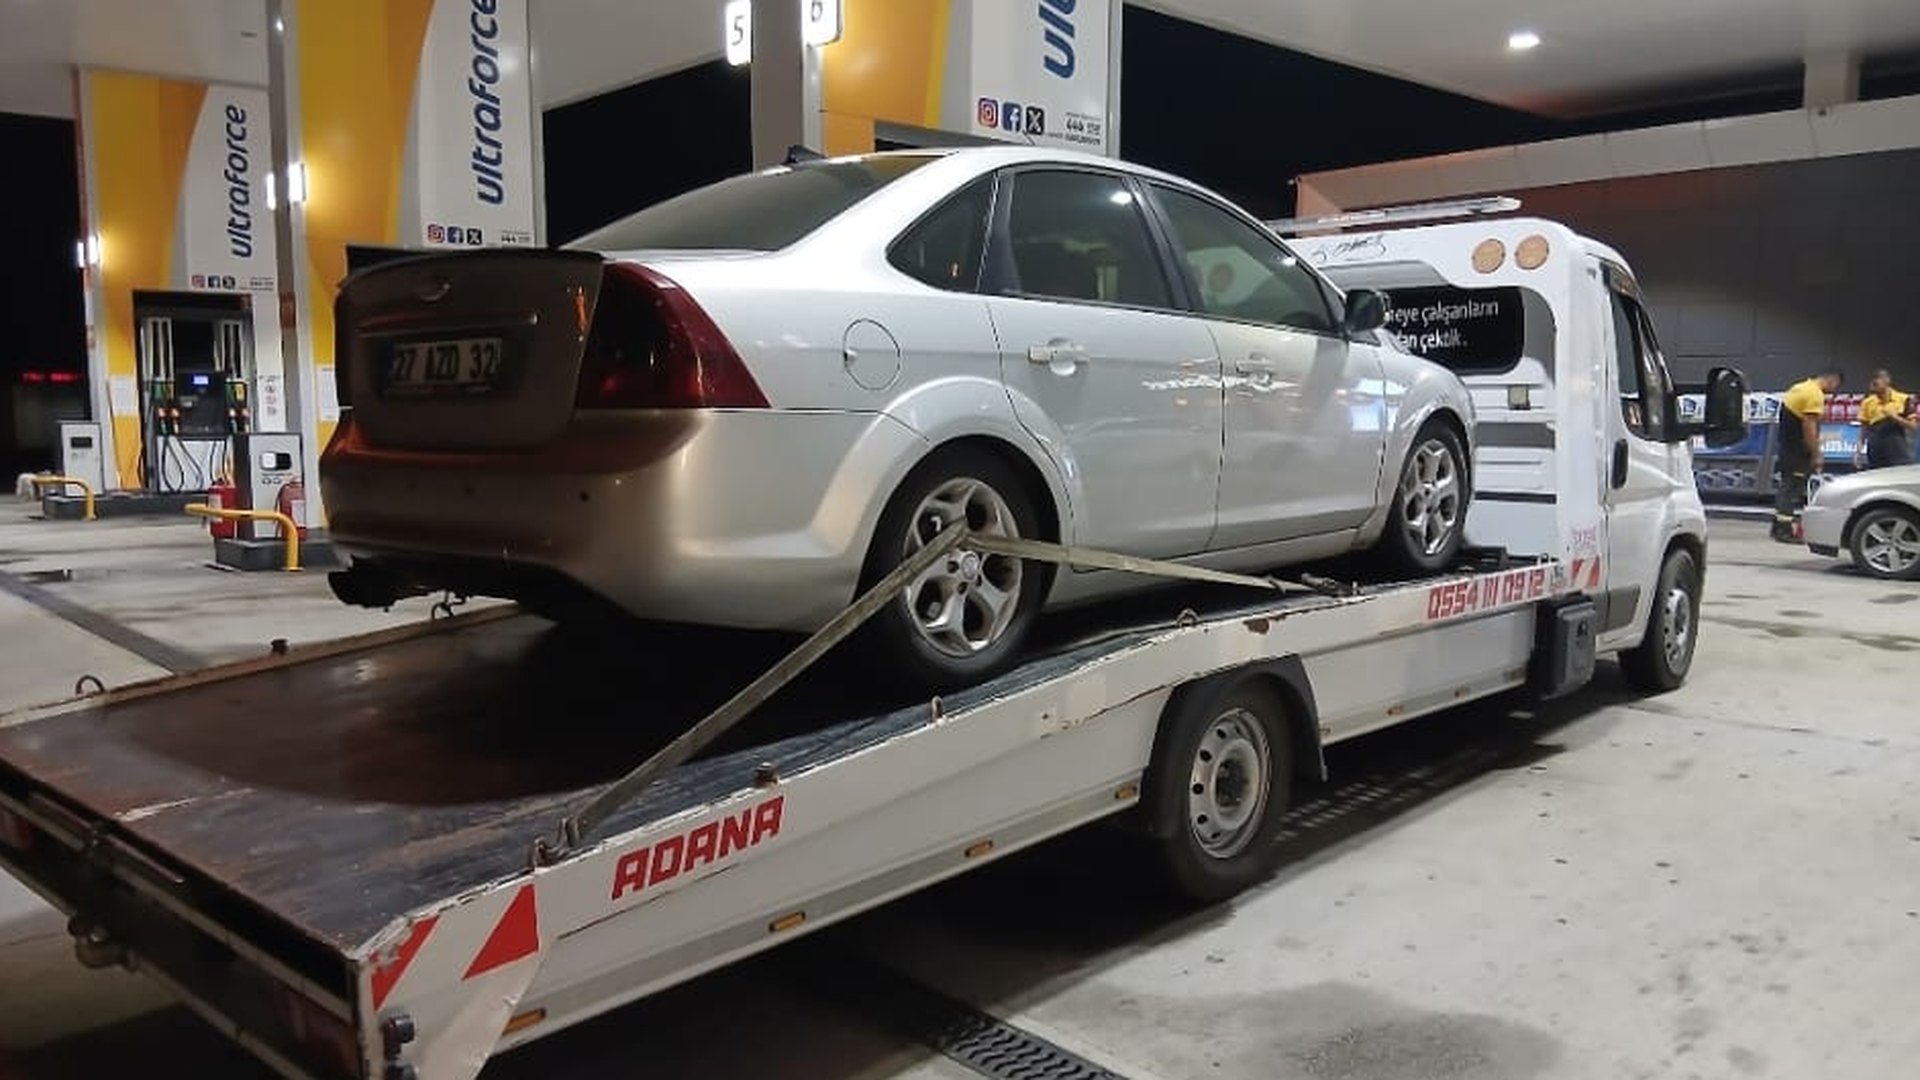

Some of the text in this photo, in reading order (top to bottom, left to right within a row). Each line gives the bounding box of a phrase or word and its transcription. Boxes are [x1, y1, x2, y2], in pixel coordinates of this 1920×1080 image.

[731, 15, 744, 46] 5
[469, 0, 504, 205] ultraforce
[224, 104, 252, 258] ultraforce
[393, 347, 417, 380] 27
[470, 342, 495, 378] 32
[1428, 580, 1478, 619] 0554
[1503, 573, 1525, 602] 09
[1528, 568, 1545, 599] 12
[612, 795, 784, 900] ADANA
